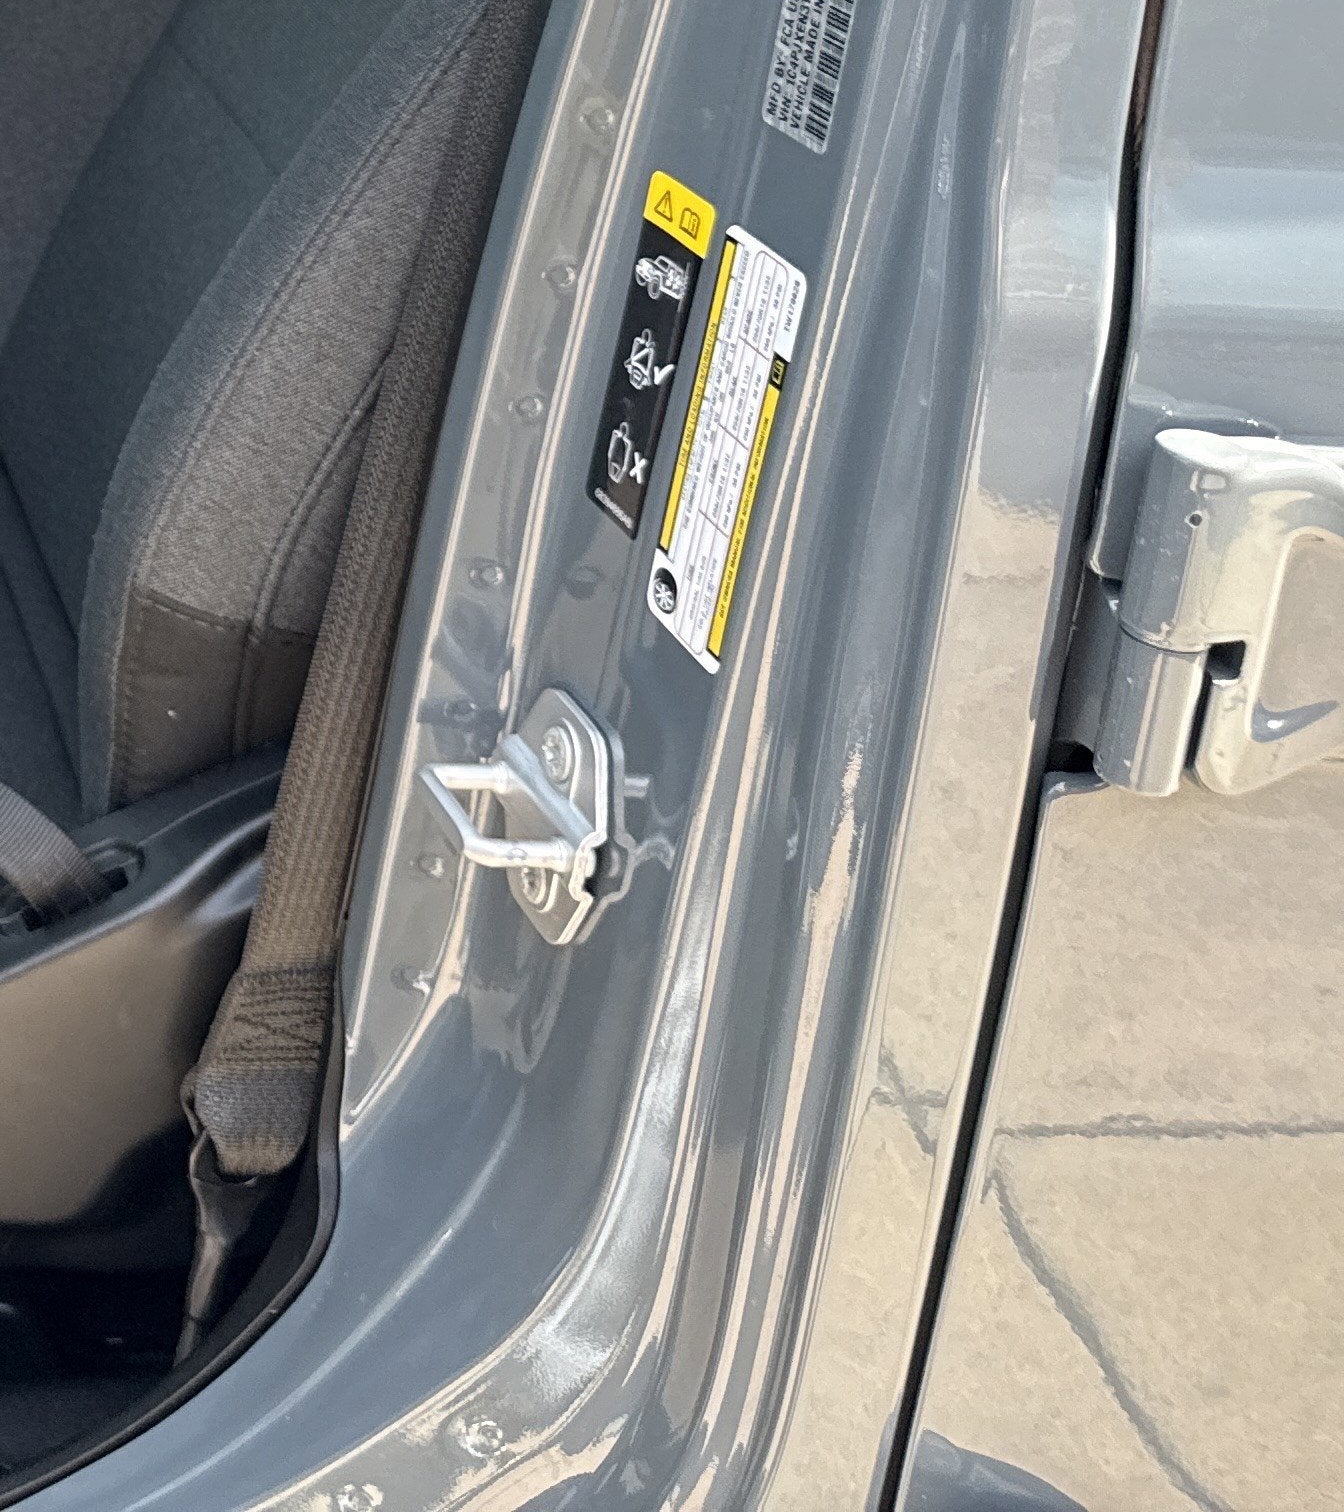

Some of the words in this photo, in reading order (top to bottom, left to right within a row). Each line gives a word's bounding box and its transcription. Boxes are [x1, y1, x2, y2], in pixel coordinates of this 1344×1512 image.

[766, 80, 781, 117] MFD
[779, 15, 794, 47] FCA
[789, 65, 810, 131] VEHICLE
[802, 16, 820, 63] MADE
